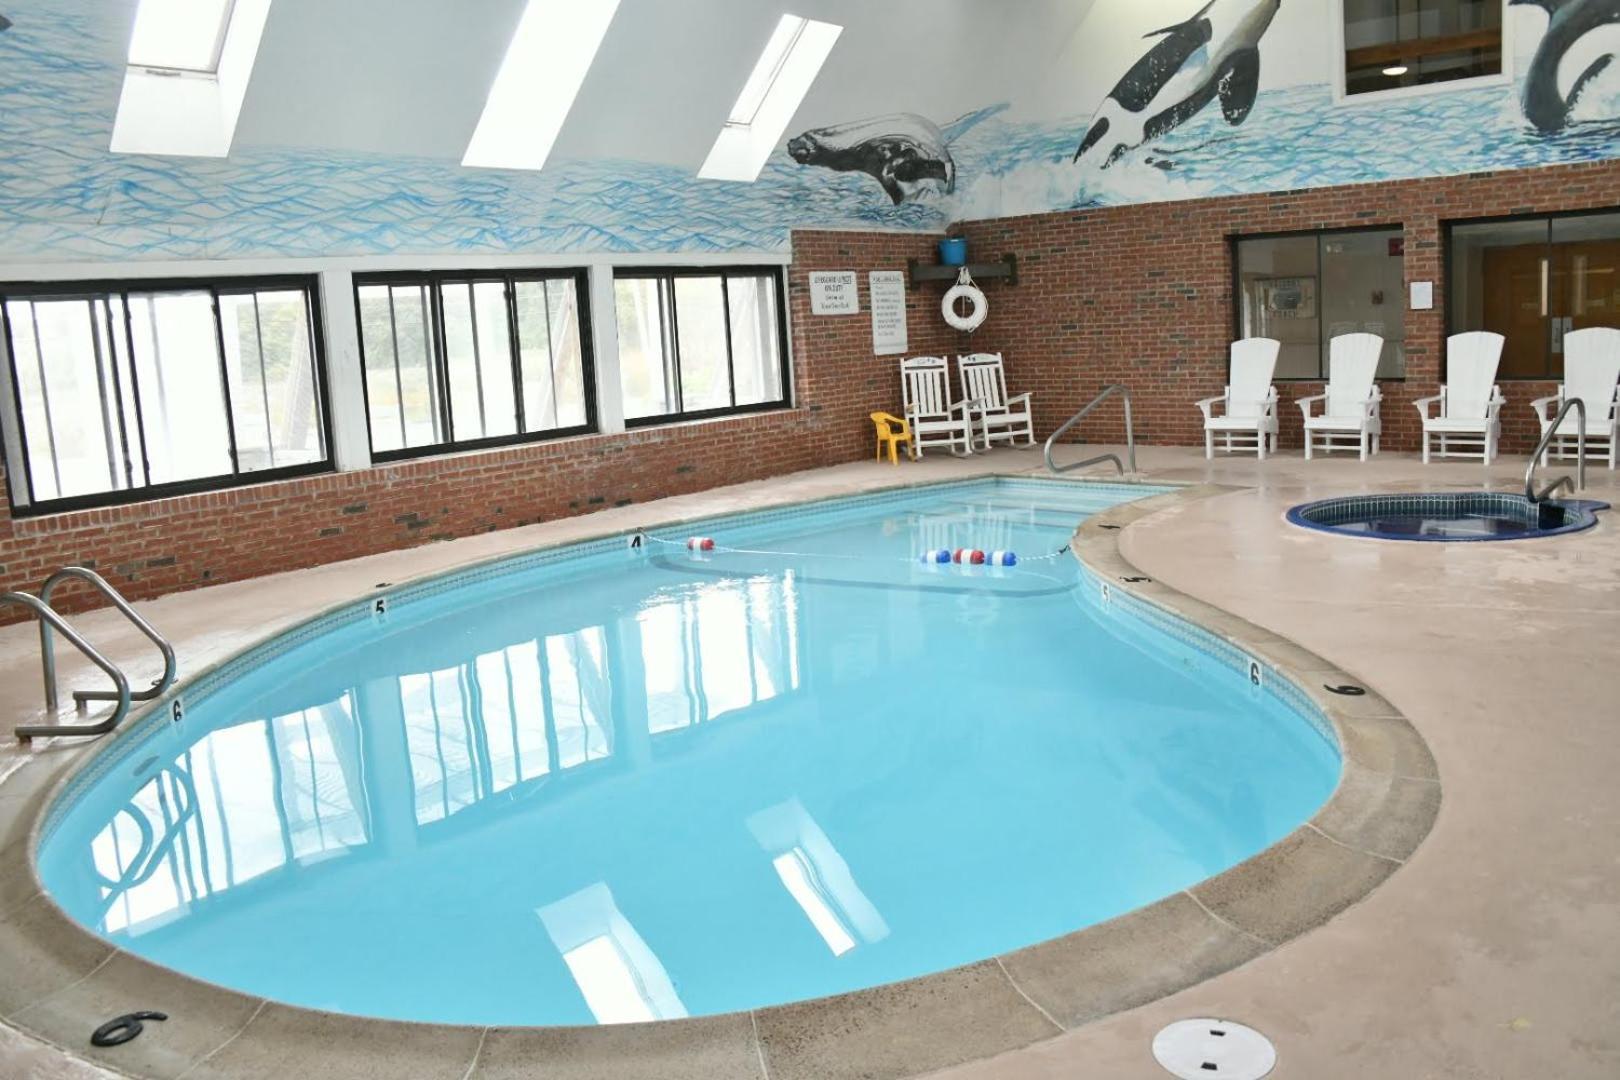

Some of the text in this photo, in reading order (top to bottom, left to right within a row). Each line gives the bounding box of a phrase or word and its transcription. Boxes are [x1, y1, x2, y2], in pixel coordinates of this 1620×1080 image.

[375, 599, 385, 614] 5
[1250, 661, 1260, 686] 6
[1322, 683, 1366, 696] 6
[172, 699, 183, 722] 6
[90, 1011, 168, 1047] 6
